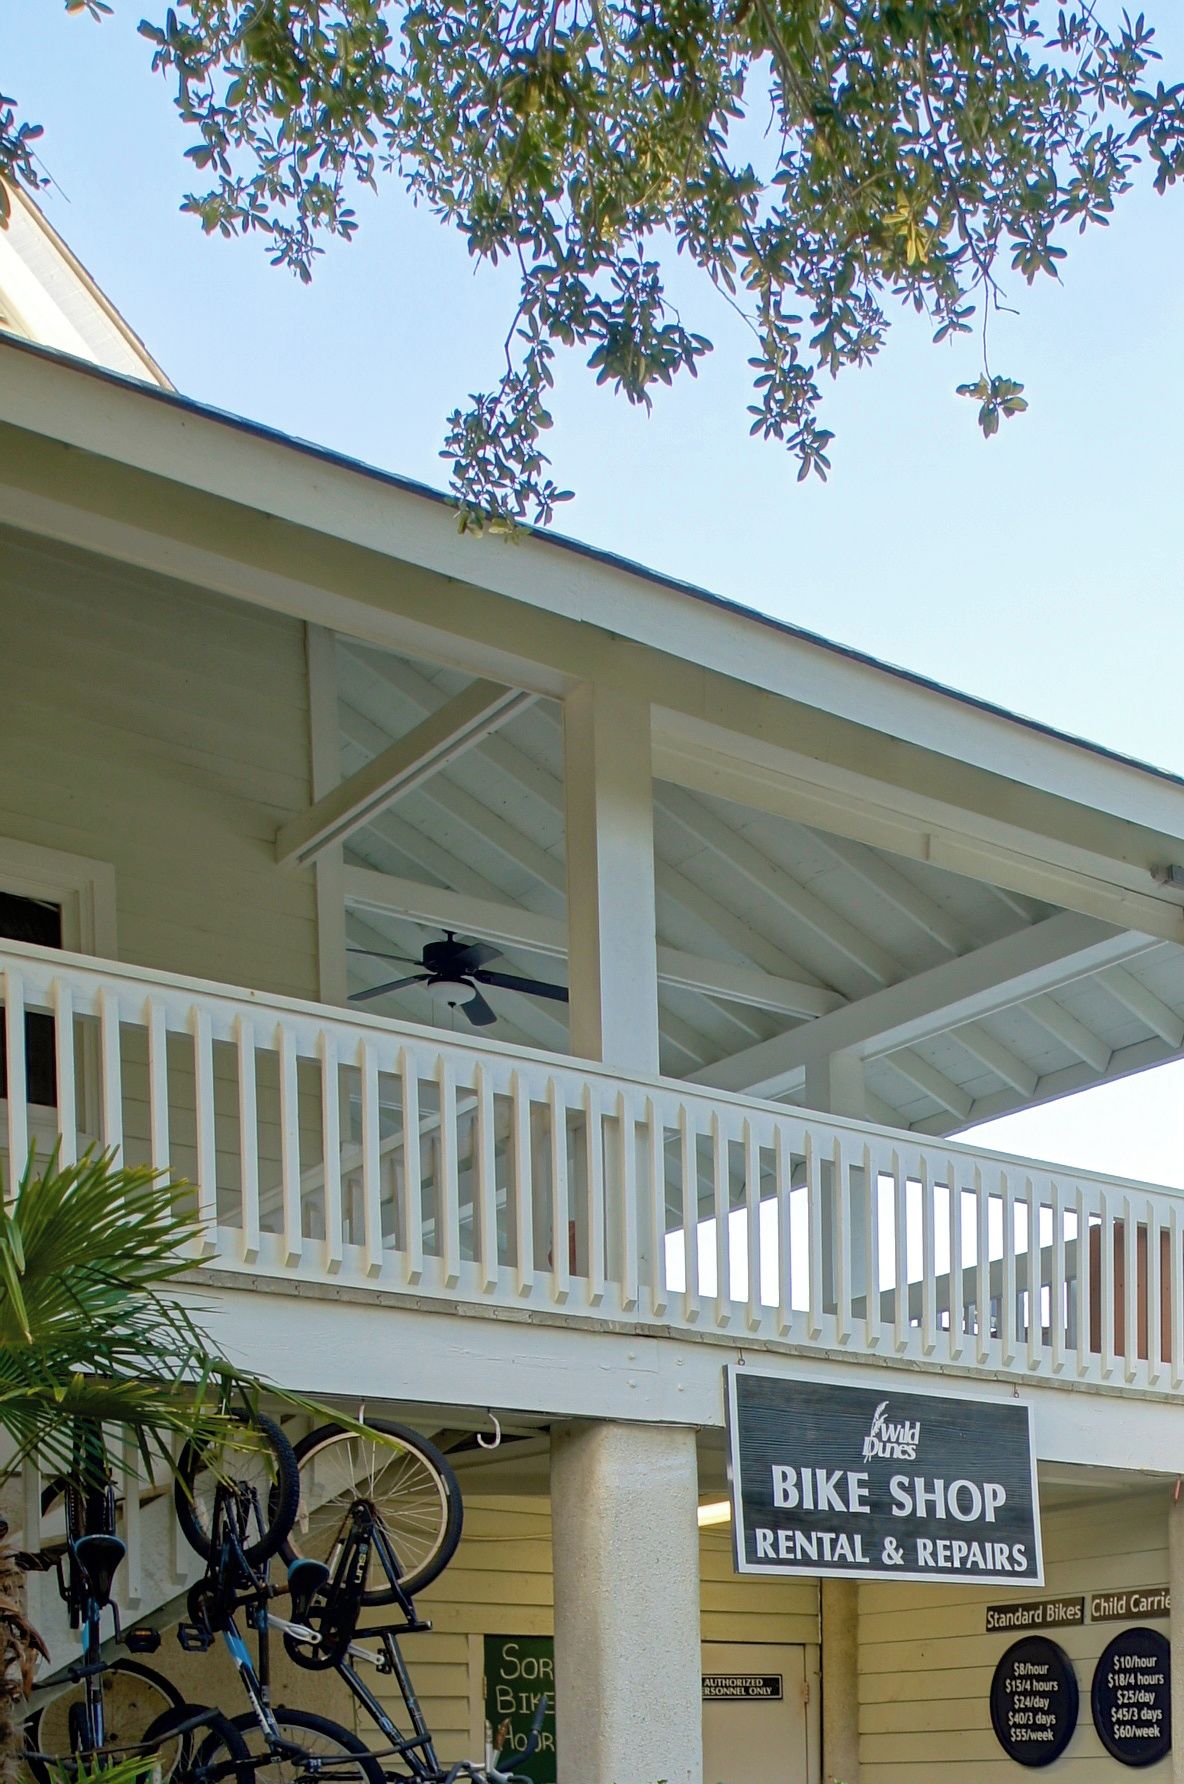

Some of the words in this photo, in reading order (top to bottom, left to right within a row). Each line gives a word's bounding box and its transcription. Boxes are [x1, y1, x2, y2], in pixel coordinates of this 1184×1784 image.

[881, 1420, 920, 1445] Wild
[862, 1436, 917, 1460] Dunes
[772, 1465, 871, 1514] BIKE
[889, 1475, 1007, 1523] SHOP
[755, 1528, 870, 1564] RENTAL
[881, 1536, 905, 1566] &
[917, 1538, 1028, 1572] REPAIRS
[1092, 1595, 1126, 1617] Child
[1130, 1591, 1171, 1612] Carrie
[987, 1605, 1043, 1629] Standard
[1046, 1603, 1081, 1622] Bikes
[500, 1643, 554, 1680] SOR
[1013, 1662, 1049, 1677] $8/hour
[1113, 1655, 1158, 1671] $10/hour
[703, 1678, 763, 1687] AUTHORIZED
[1005, 1678, 1031, 1694] $15/4
[1032, 1678, 1059, 1691] hours
[1107, 1672, 1135, 1689] $18/4
[1137, 1672, 1165, 1686] hours
[702, 1686, 746, 1696] RSONNEL
[748, 1686, 772, 1696] ONLY
[1116, 1689, 1156, 1706] $25/day
[1013, 1694, 1050, 1711] $24/day
[1008, 1710, 1034, 1726] $40/3
[1035, 1711, 1057, 1727] days
[1110, 1706, 1139, 1723] $45/3
[1140, 1706, 1163, 1722] days
[1010, 1727, 1054, 1743] $55/week
[1113, 1724, 1161, 1740] $60/week
